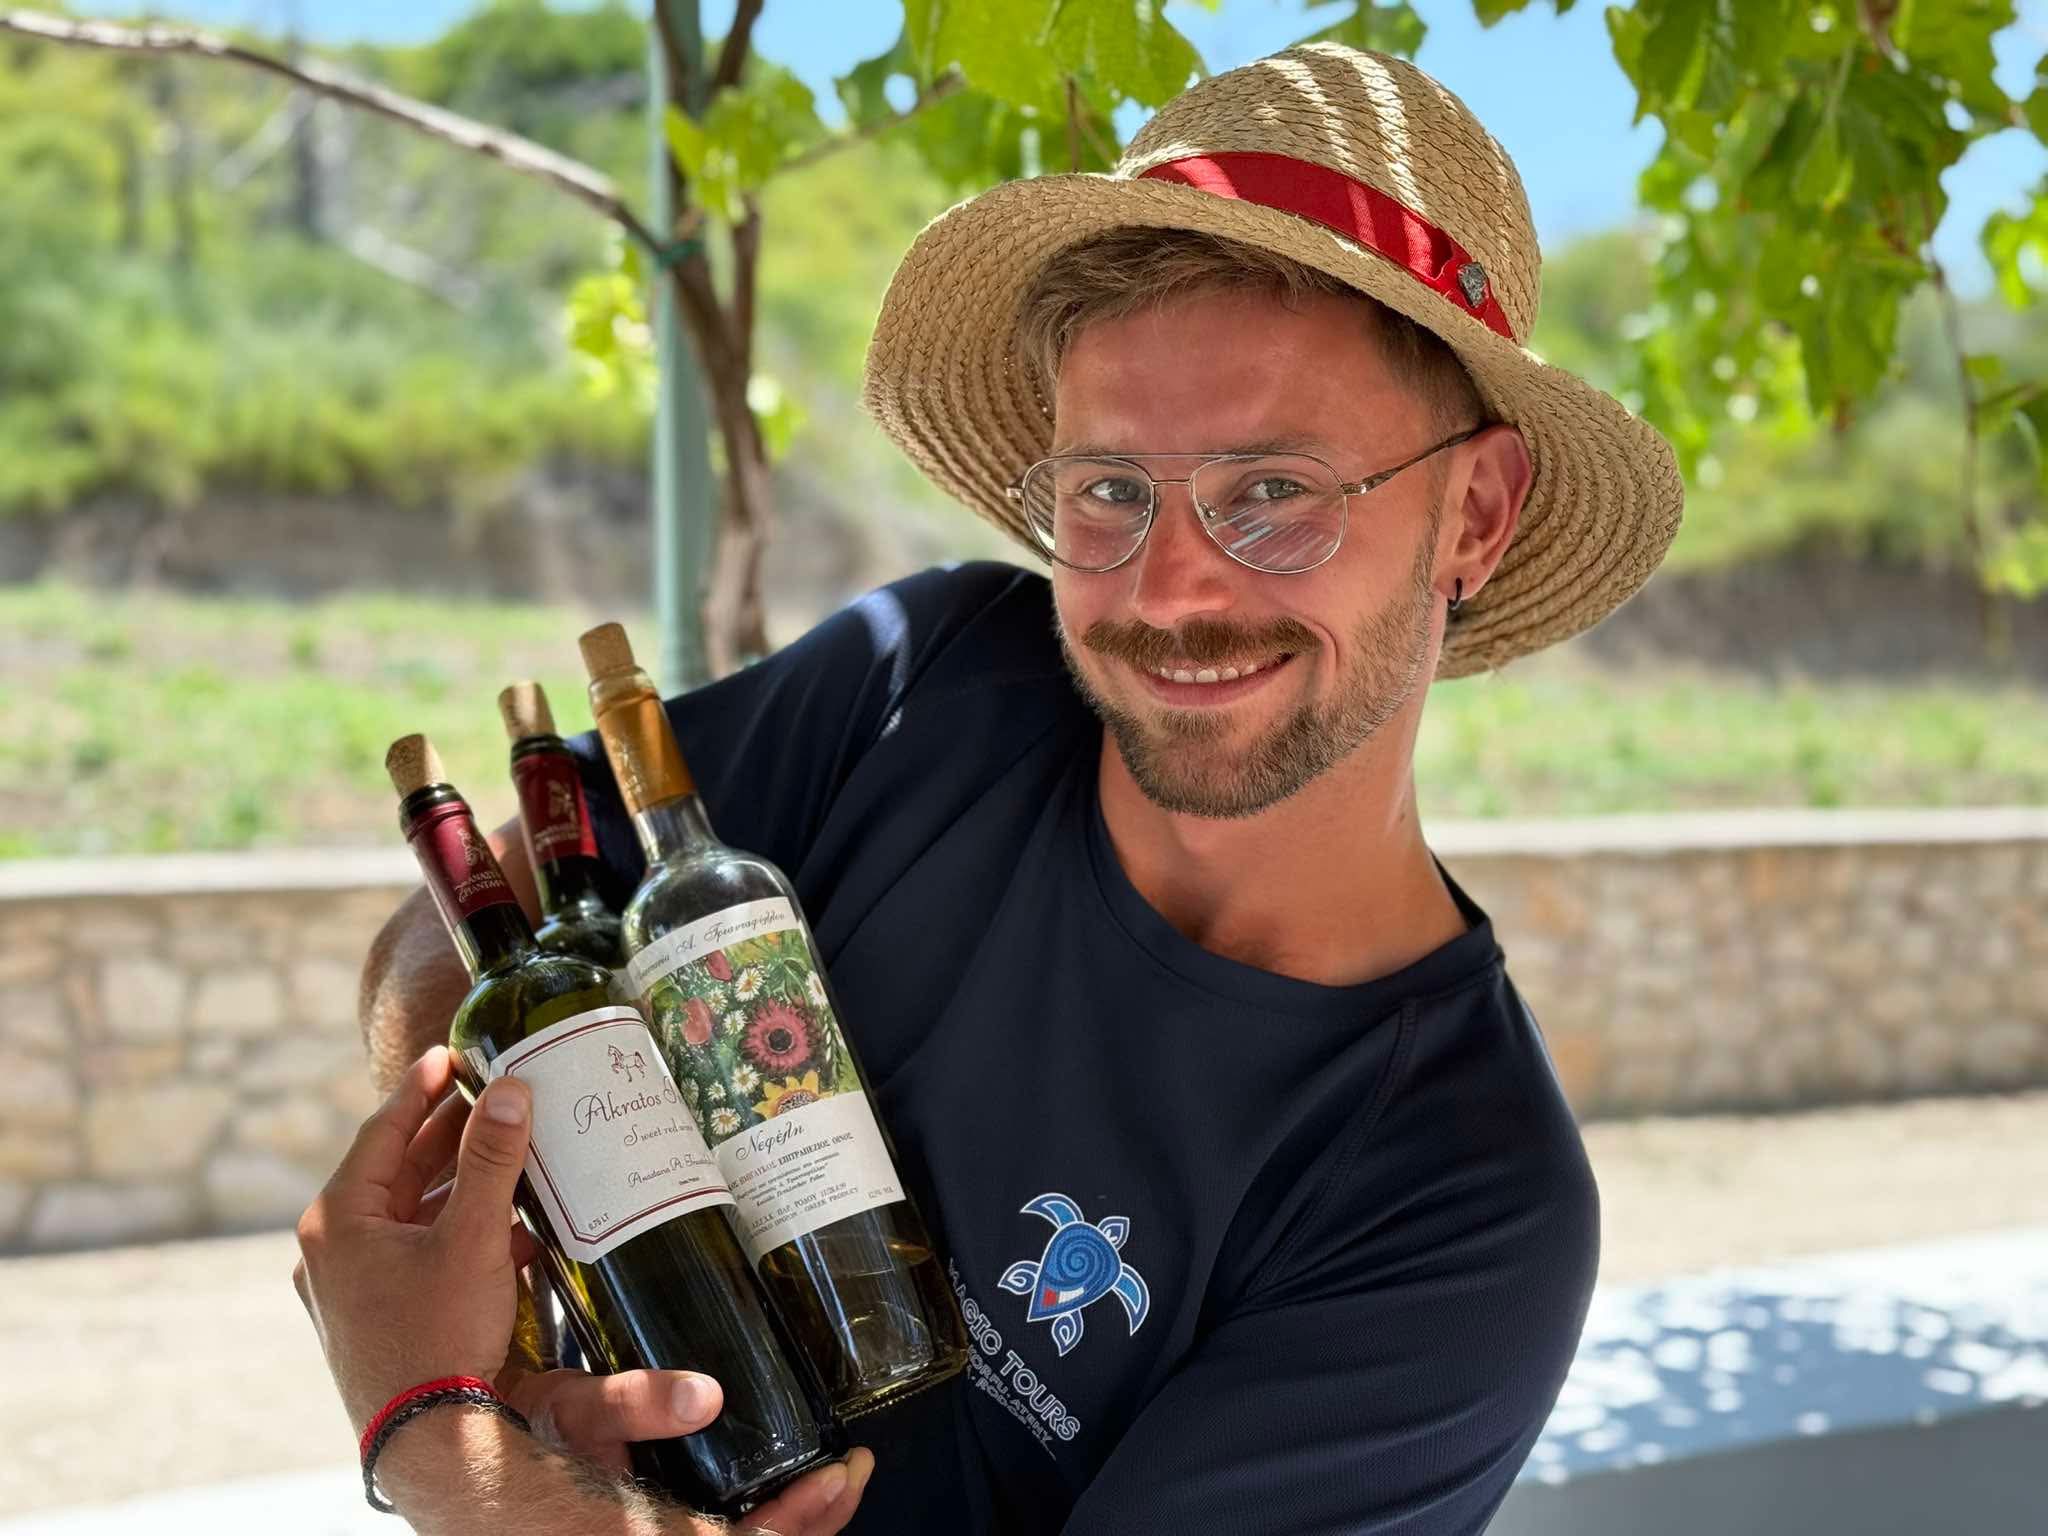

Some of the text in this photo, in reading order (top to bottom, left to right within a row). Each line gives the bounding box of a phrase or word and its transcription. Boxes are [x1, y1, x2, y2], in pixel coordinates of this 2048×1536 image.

[573, 1091, 662, 1134] Akratos
[623, 1123, 662, 1146] Sweet
[664, 1117, 679, 1135] red
[735, 1120, 805, 1161] Νεφέλη
[1000, 1350, 1081, 1442] TOURS
